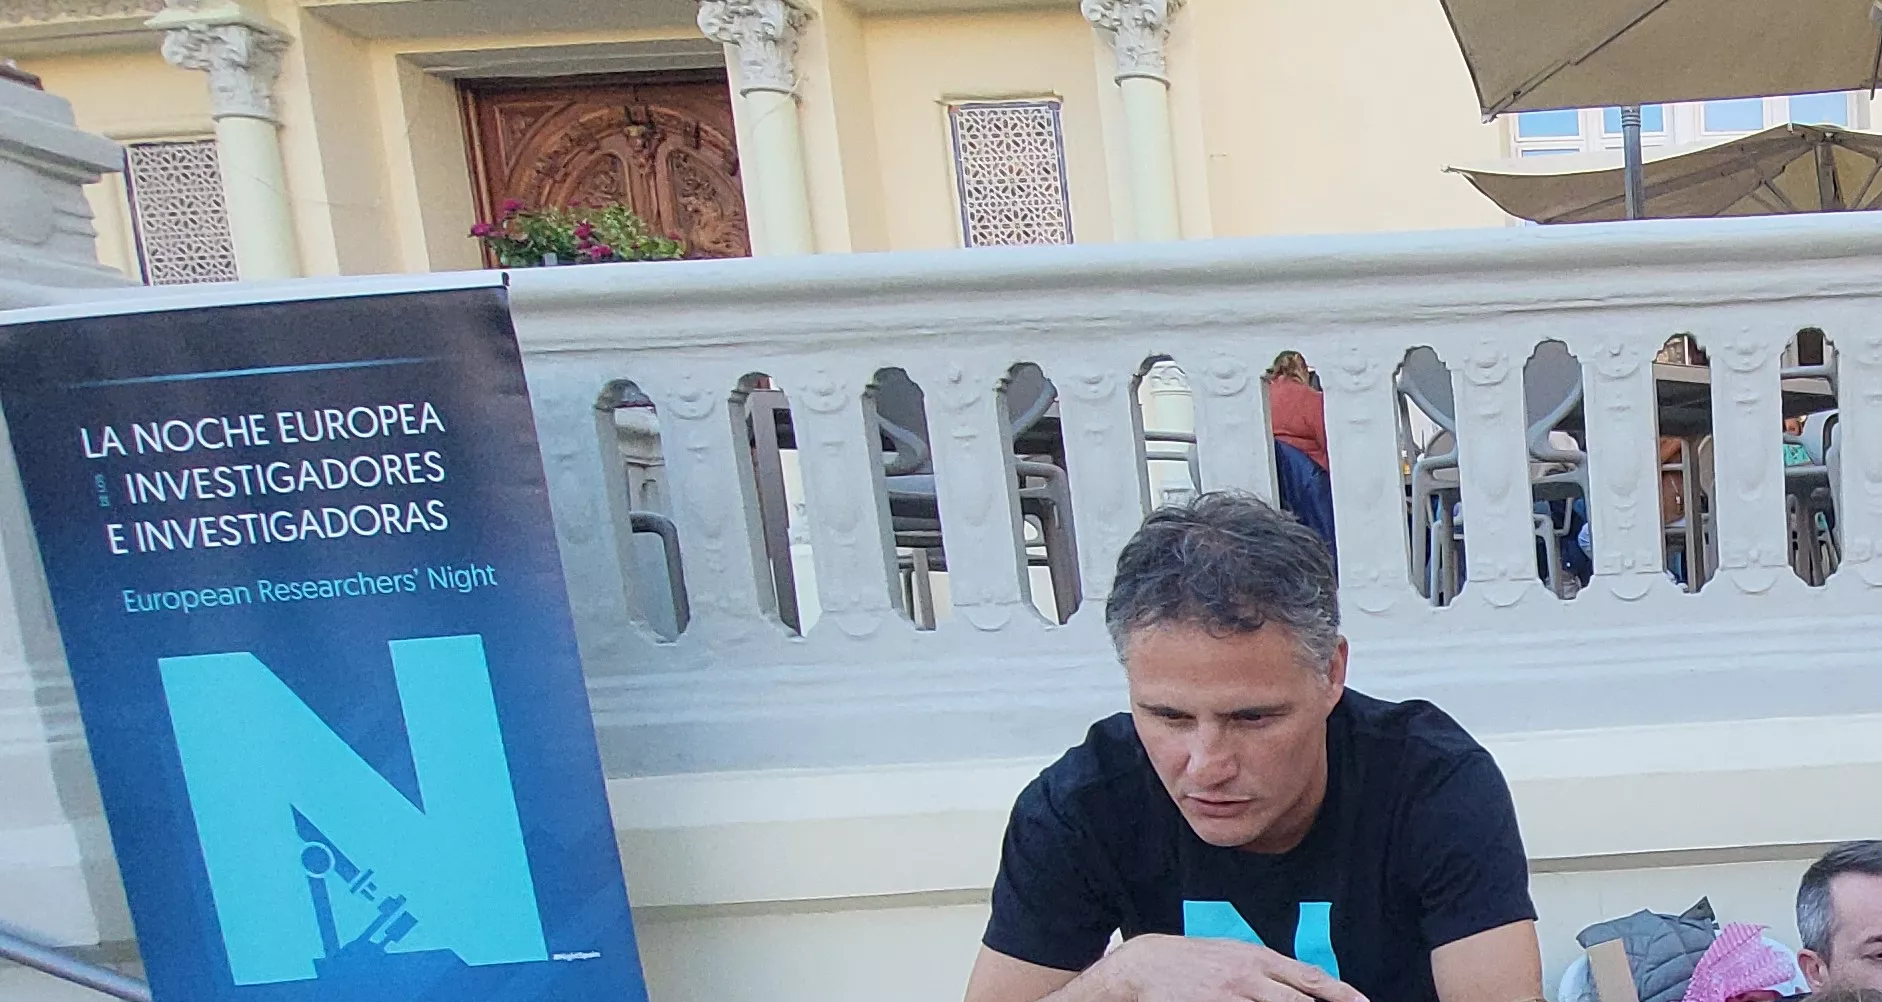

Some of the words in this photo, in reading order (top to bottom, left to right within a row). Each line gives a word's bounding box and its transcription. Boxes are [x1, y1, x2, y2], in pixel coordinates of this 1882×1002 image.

[80, 425, 128, 459] LA
[131, 414, 270, 454] NOCHE
[276, 402, 446, 443] EUROPEA
[125, 451, 445, 504] INVESTIGADORES
[107, 523, 129, 555] E
[135, 500, 448, 552] INVESTIGADORAS
[122, 585, 252, 614] European
[427, 563, 498, 593] Night
[158, 634, 548, 986] N
